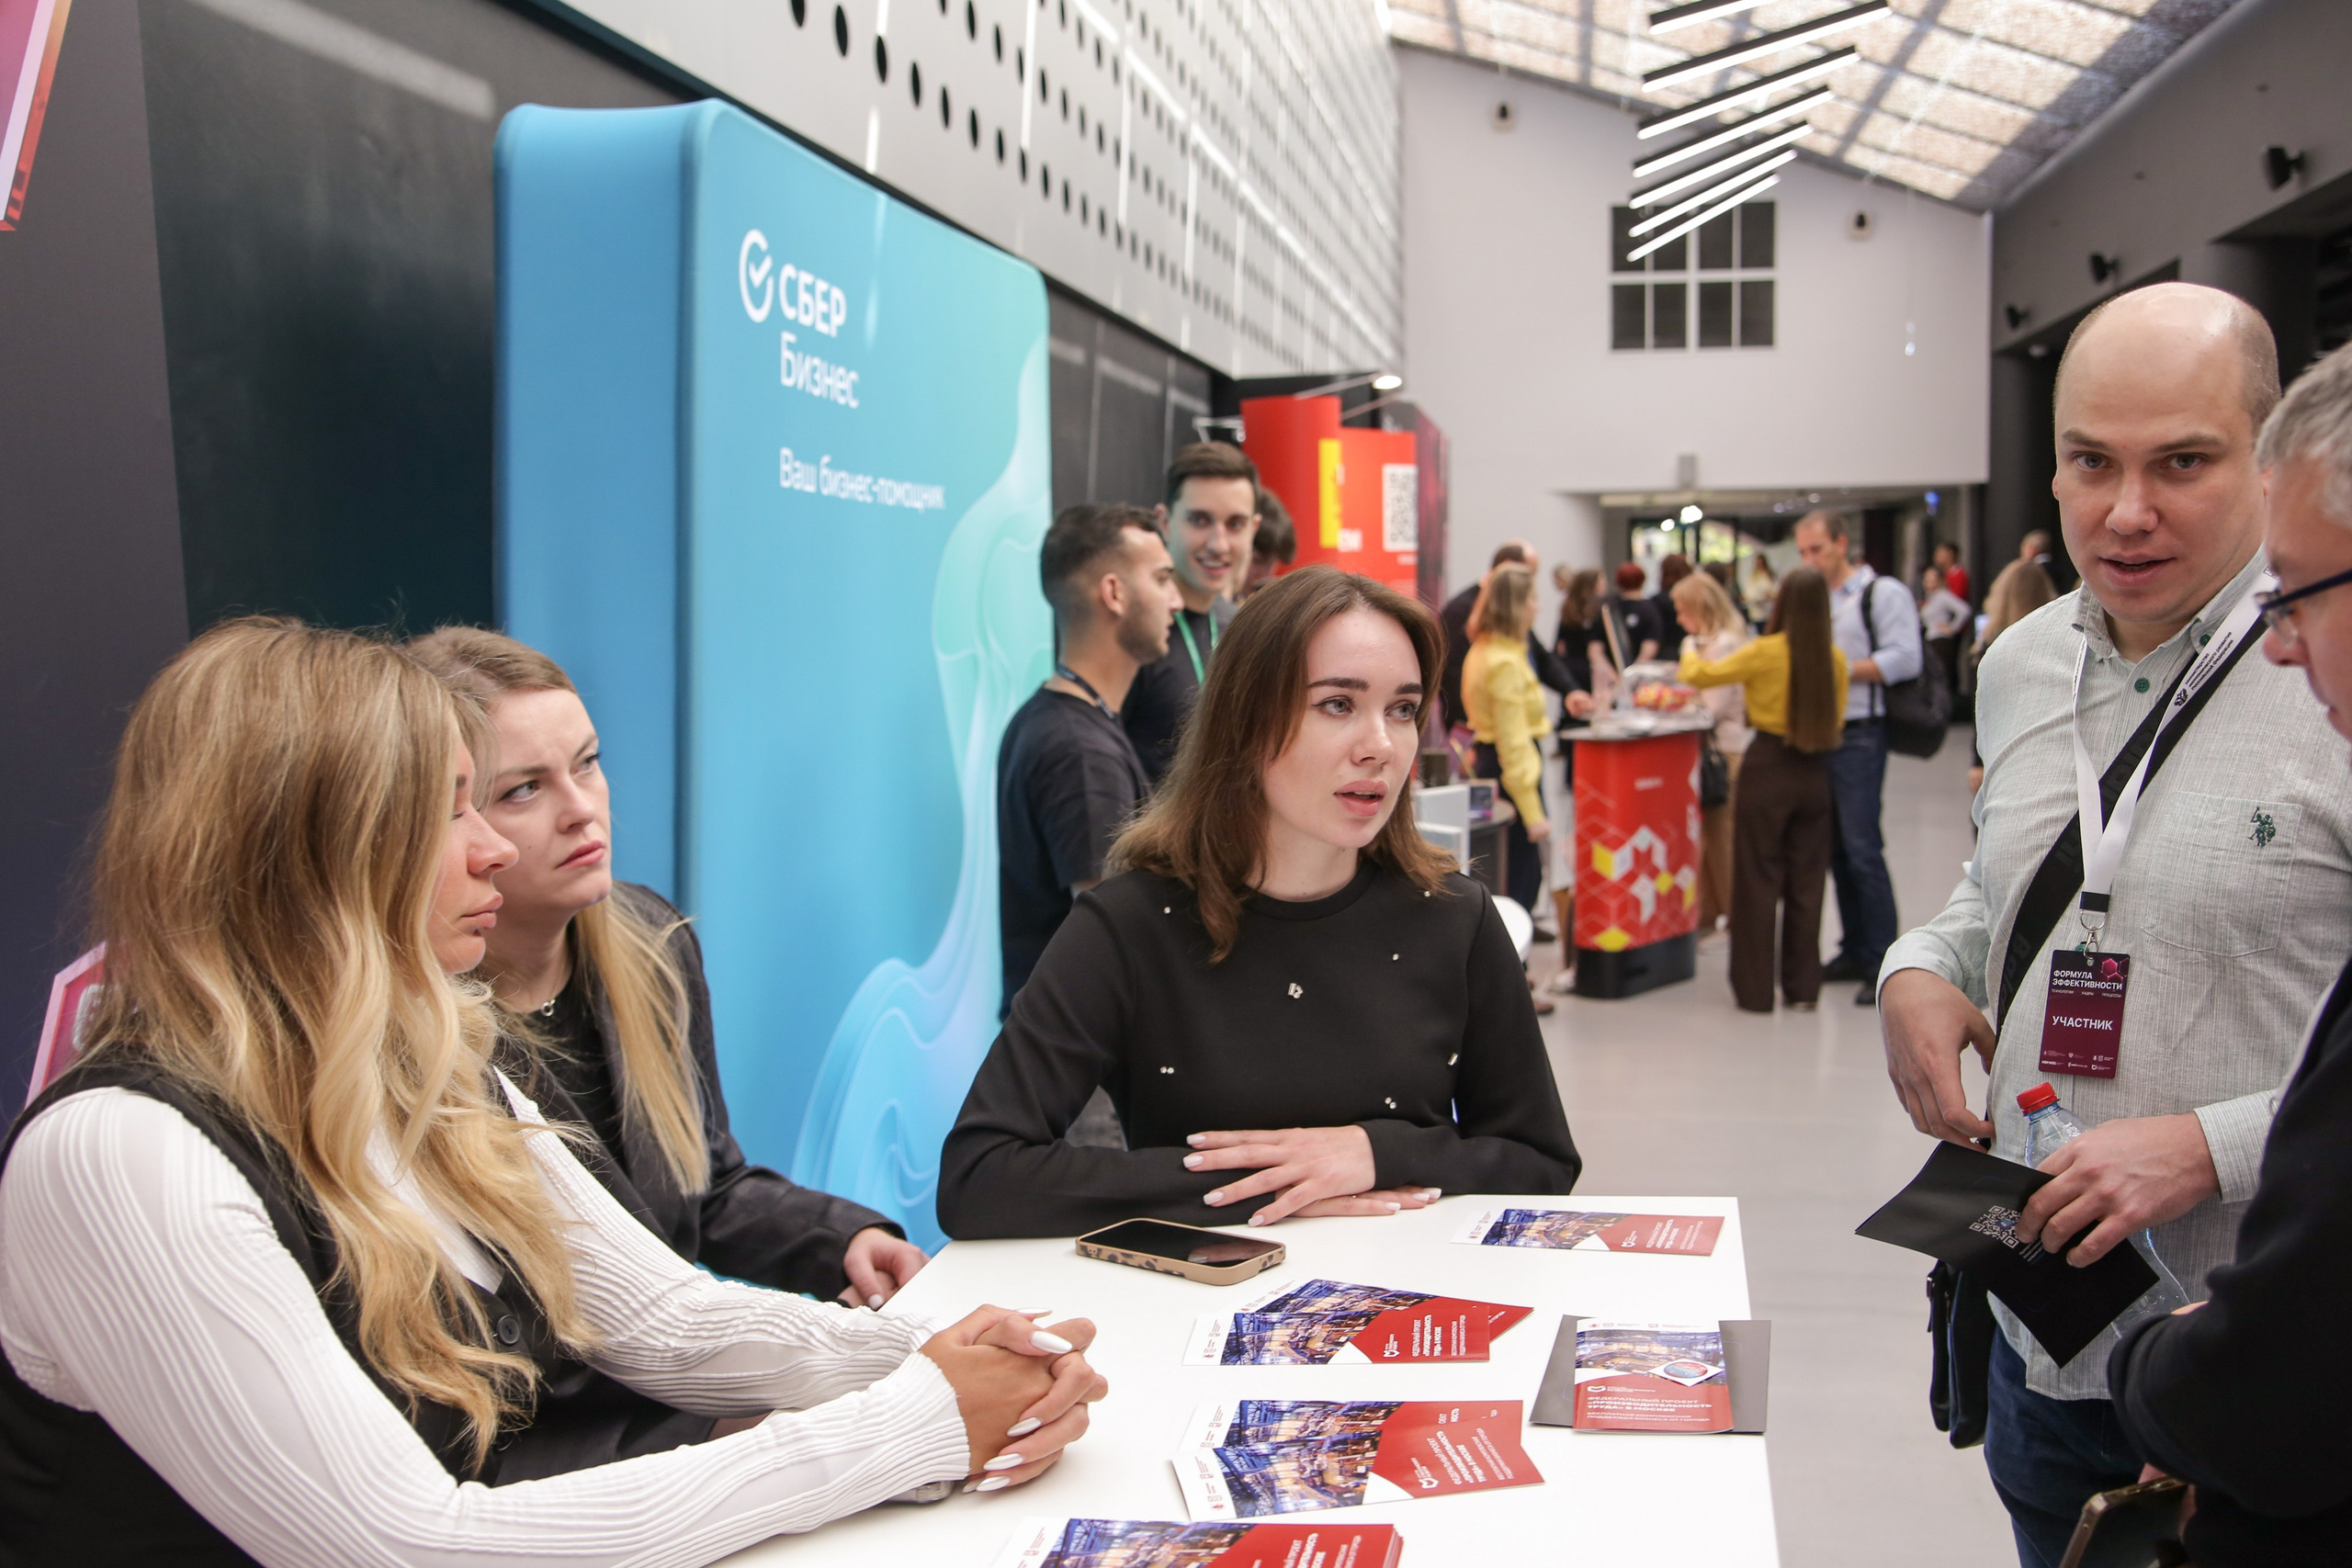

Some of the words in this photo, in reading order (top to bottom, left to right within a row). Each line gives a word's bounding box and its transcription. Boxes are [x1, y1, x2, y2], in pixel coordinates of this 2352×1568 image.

[779, 263, 847, 338] СБЕР
[780, 330, 859, 409] Бизнес
[780, 446, 817, 493] Ваш
[820, 454, 945, 513] бизнес-помощник
[2052, 977, 2122, 990] ЭФФЕКТИВНОСТИ
[2053, 969, 2093, 979] ФОРМУЛА
[2052, 1015, 2113, 1031] УЧАСТНИК
